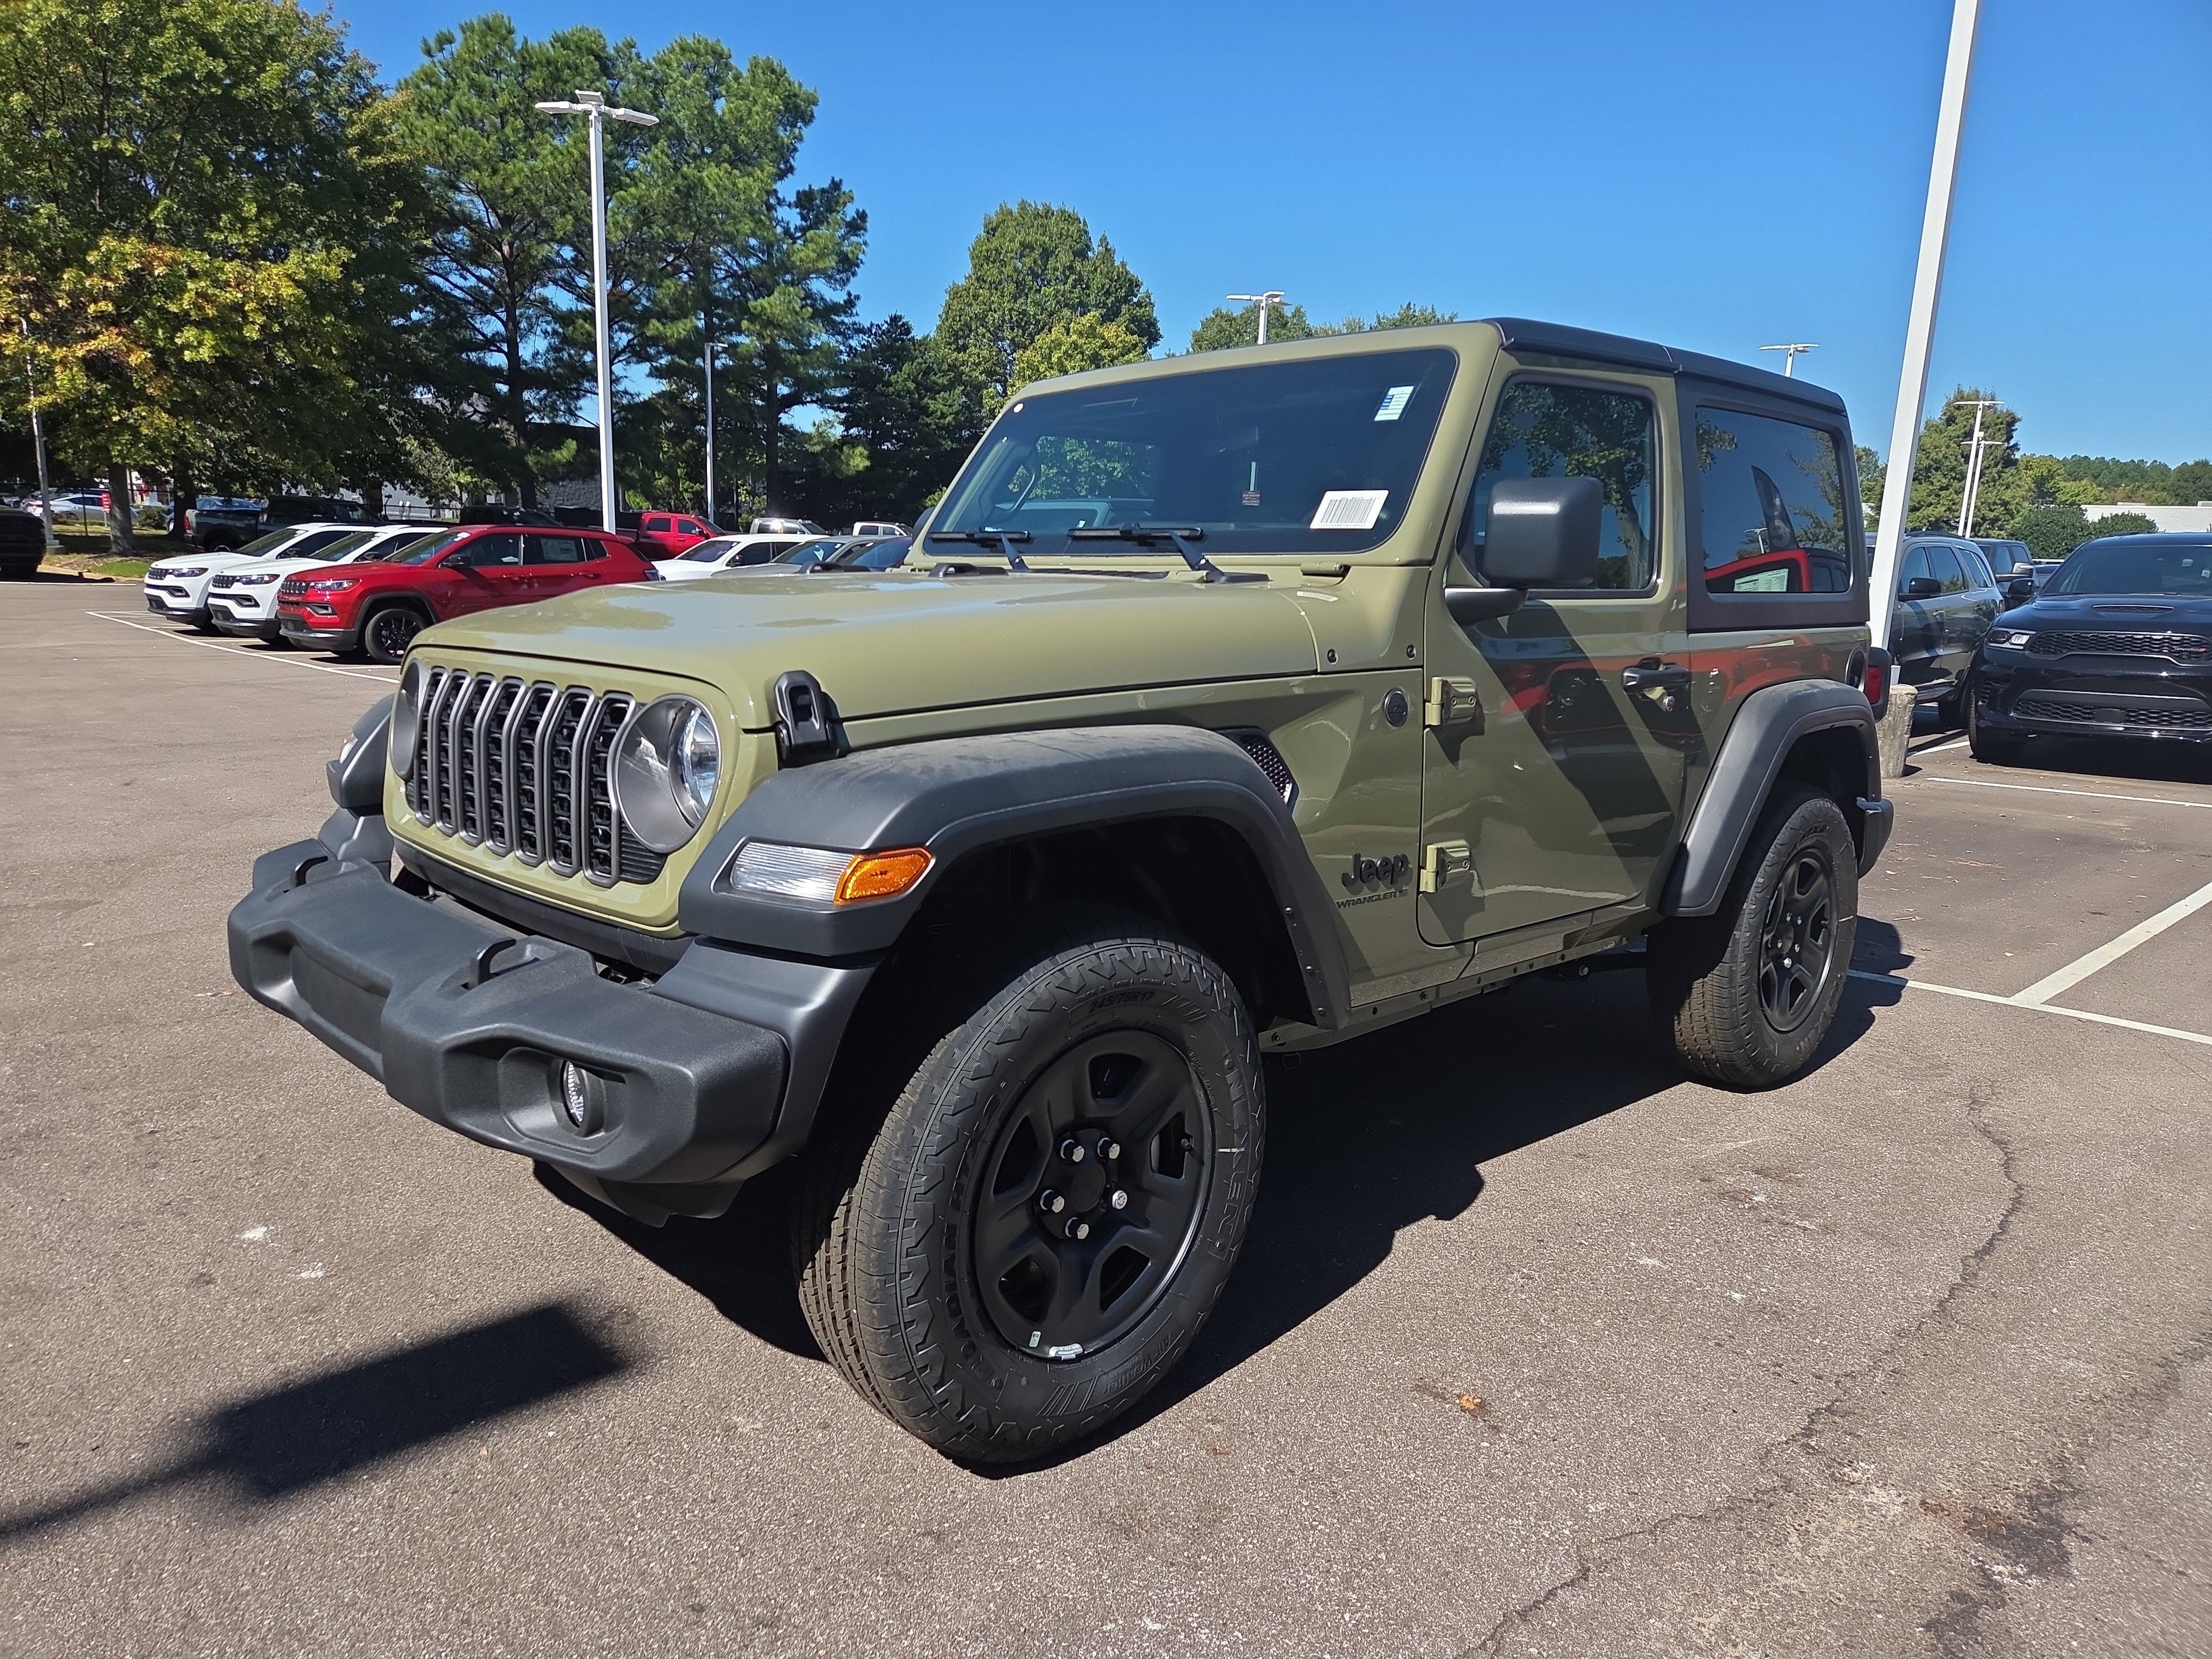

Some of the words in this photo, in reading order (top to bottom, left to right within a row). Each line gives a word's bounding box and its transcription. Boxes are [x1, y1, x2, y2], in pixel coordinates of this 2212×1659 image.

[1341, 852, 1410, 888] Jeep
[1336, 891, 1397, 909] WRANGLER
[1088, 991, 1156, 1013] 245/75R17
[1218, 1069, 1249, 1237] NEXEN
[942, 1223, 994, 1382] ROADIAN
